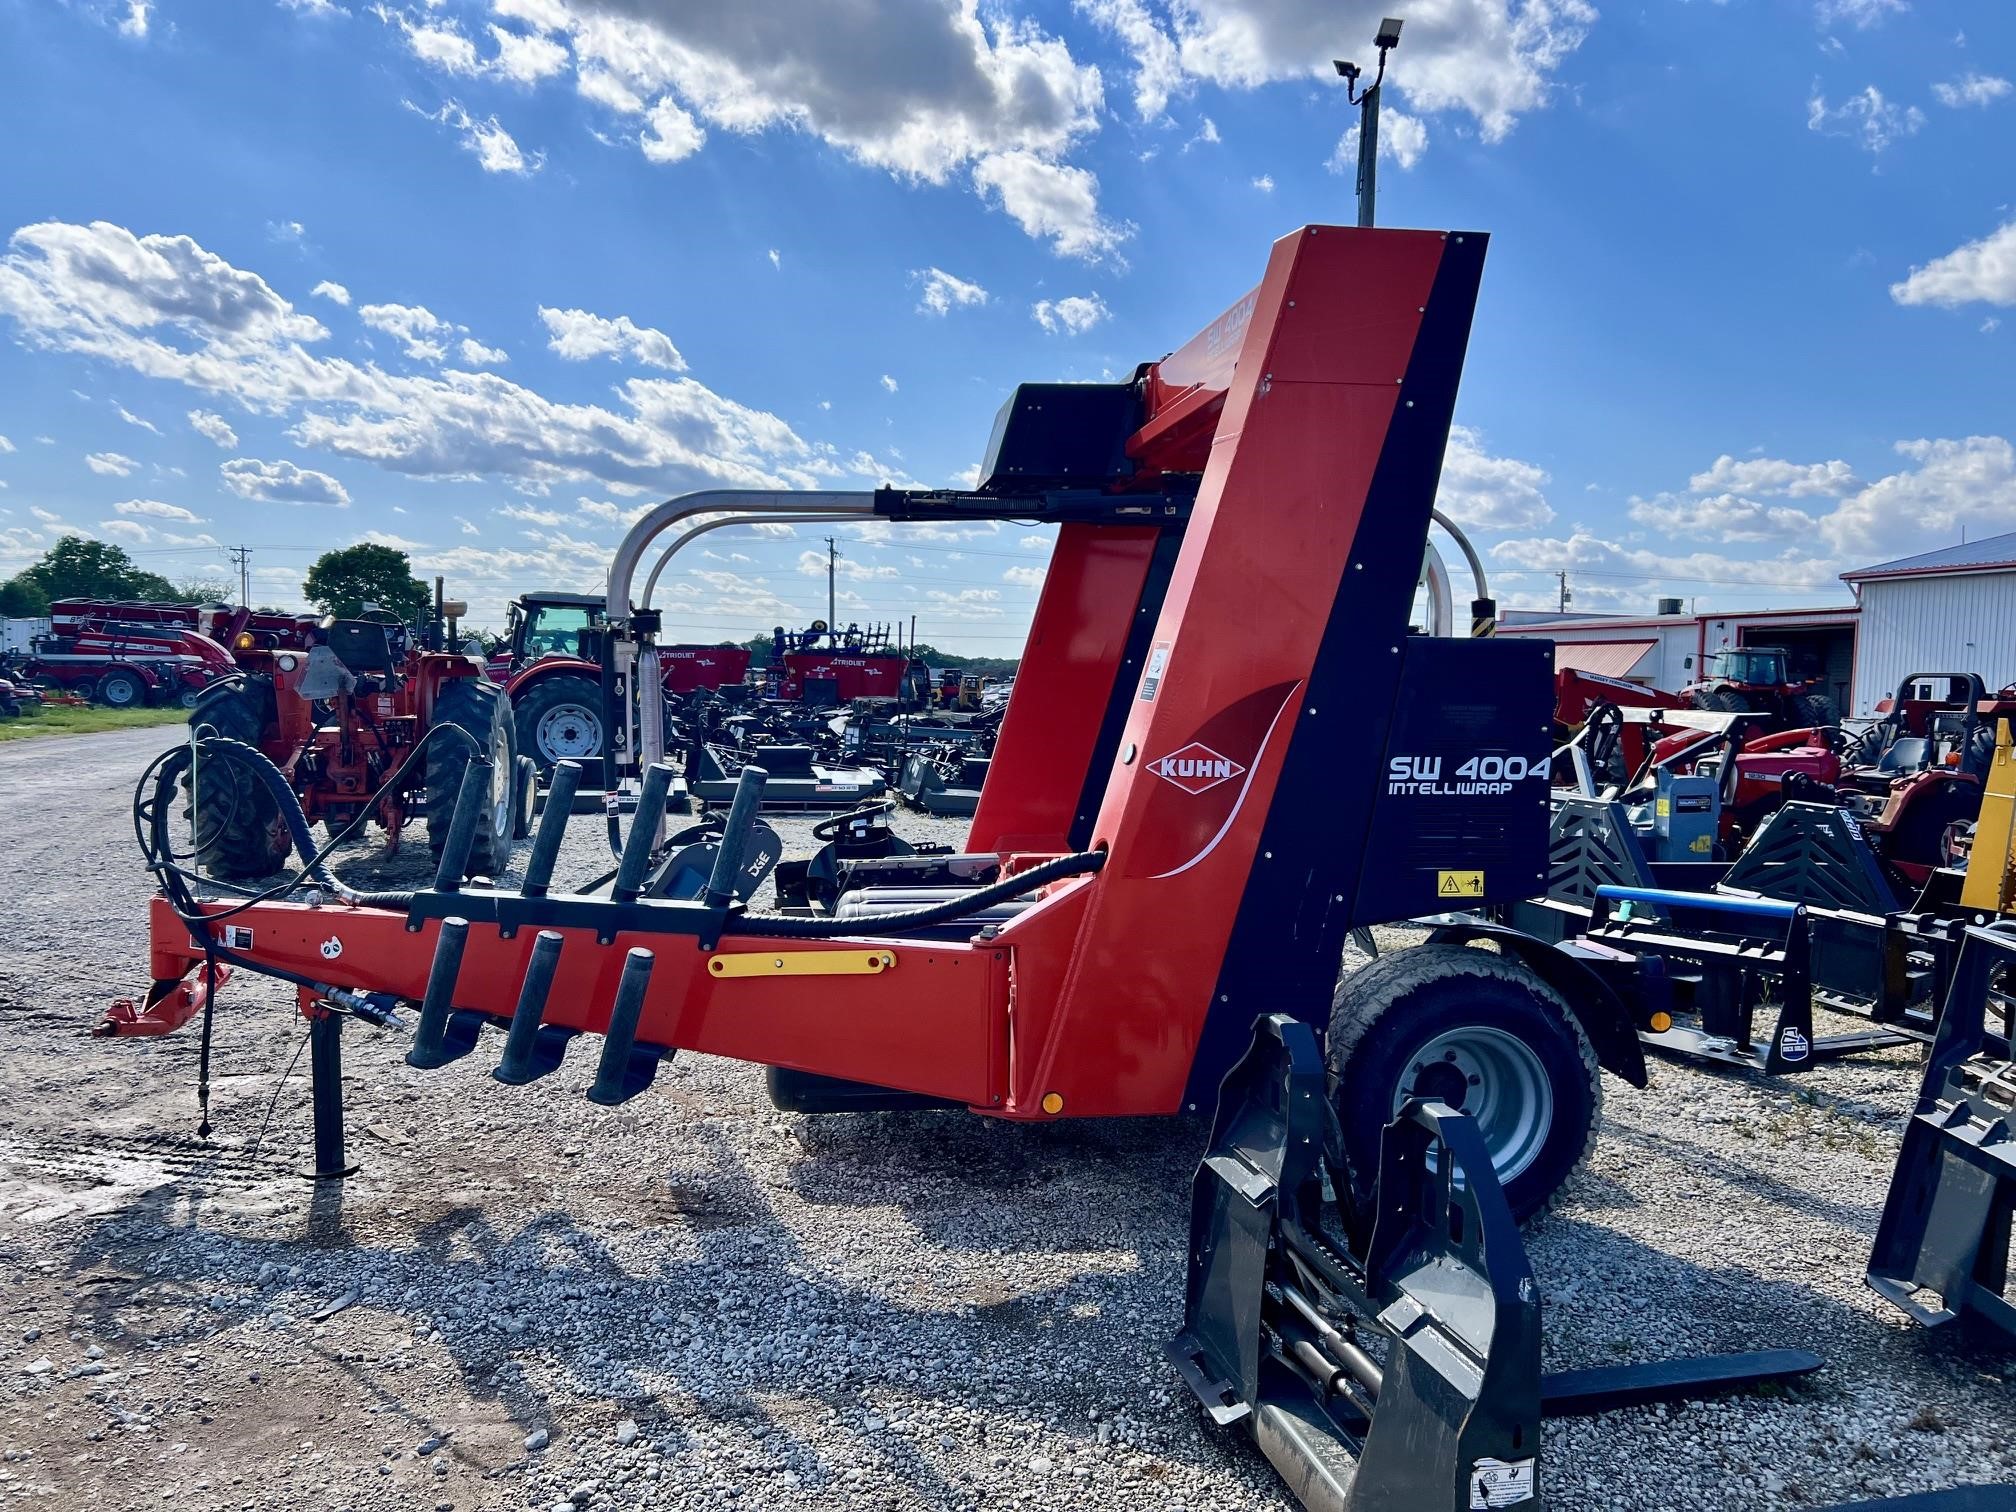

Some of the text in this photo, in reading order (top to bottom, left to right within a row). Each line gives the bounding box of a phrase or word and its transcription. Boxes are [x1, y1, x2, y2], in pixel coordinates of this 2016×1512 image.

[659, 651, 696, 659] TRIOLIET
[1589, 674, 1608, 683] MASSEY
[1160, 758, 1231, 778] KUHN
[1389, 756, 1551, 780] SW 4004
[1388, 782, 1513, 795] INTELLIWRAP
[747, 850, 771, 878] DGE
